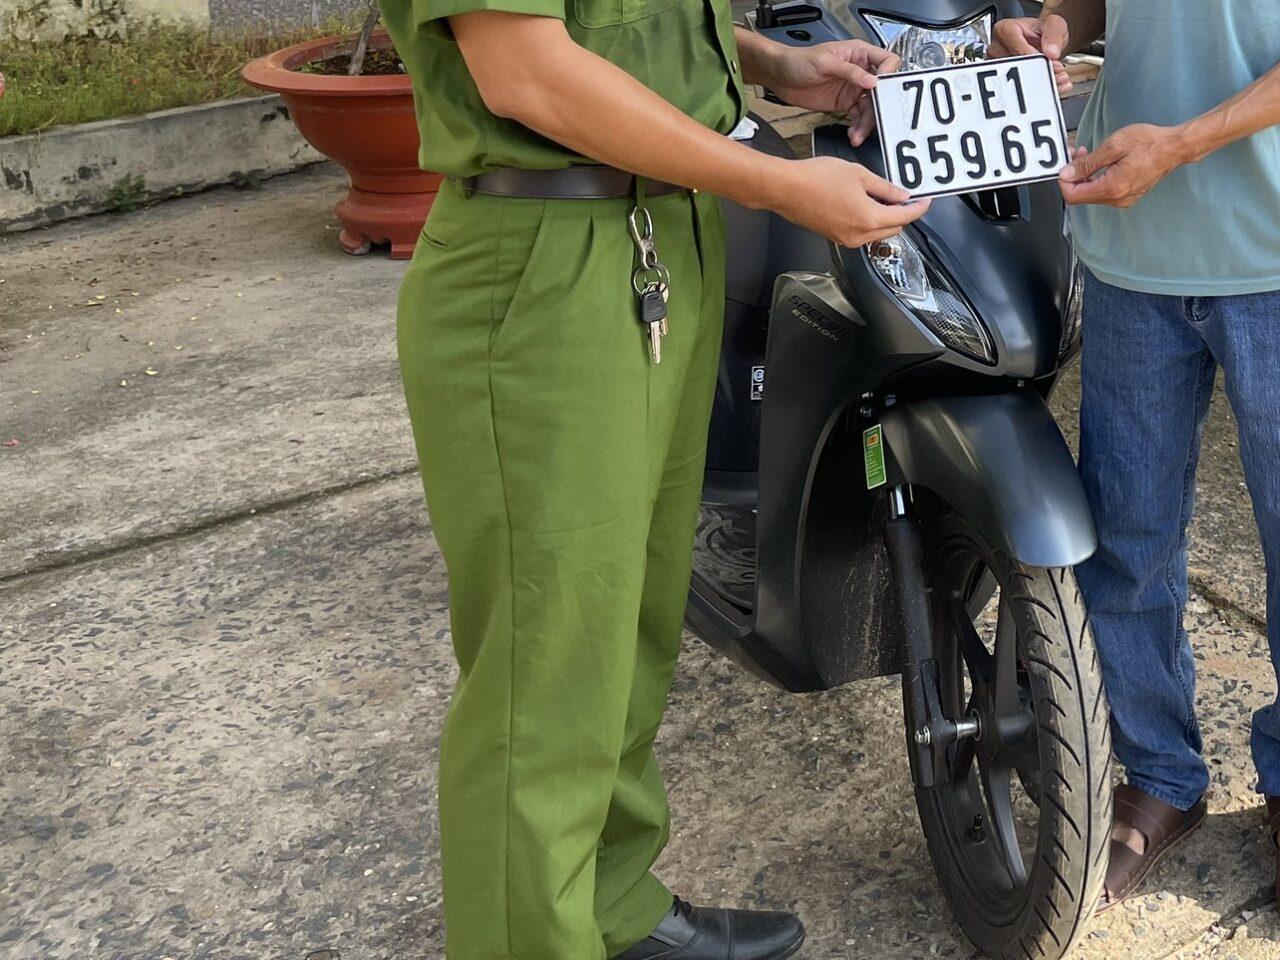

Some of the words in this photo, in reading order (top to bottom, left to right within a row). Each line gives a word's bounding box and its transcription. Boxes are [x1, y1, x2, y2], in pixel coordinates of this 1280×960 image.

[902, 66, 1027, 130] 70-E1
[896, 119, 1059, 189] 659.65
[791, 309, 840, 343] EDITION
